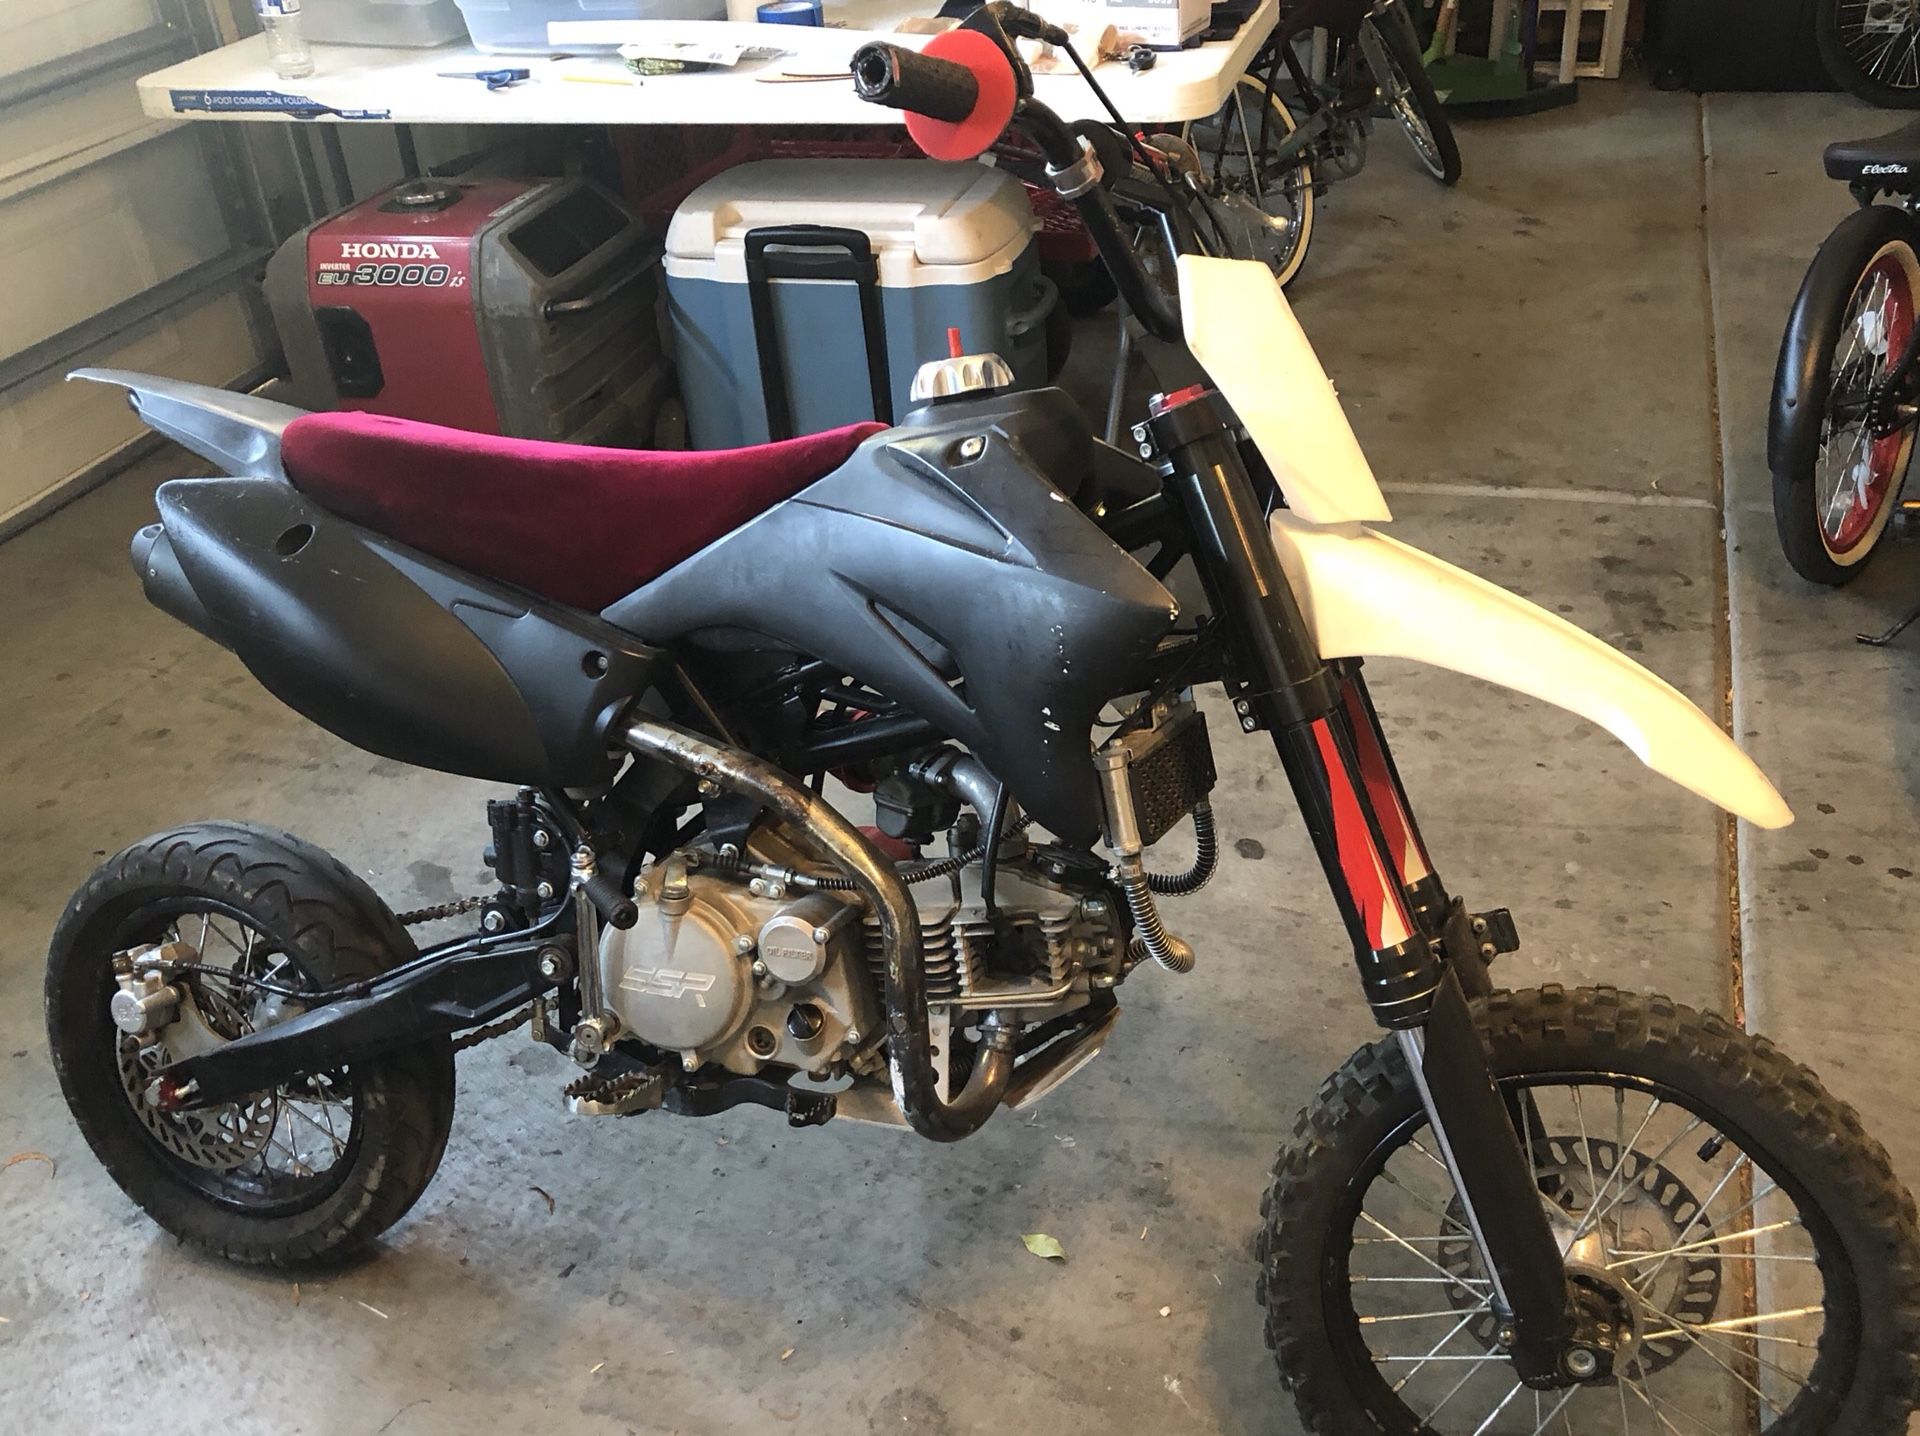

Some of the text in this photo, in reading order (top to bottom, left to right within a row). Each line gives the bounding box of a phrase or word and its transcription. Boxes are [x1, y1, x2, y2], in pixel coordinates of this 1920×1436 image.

[233, 96, 283, 105] COMMERCIAL
[1861, 164, 1909, 175] Electra
[340, 243, 440, 259] HONDA
[319, 263, 351, 271] INVERTER
[782, 947, 814, 961] FILTER
